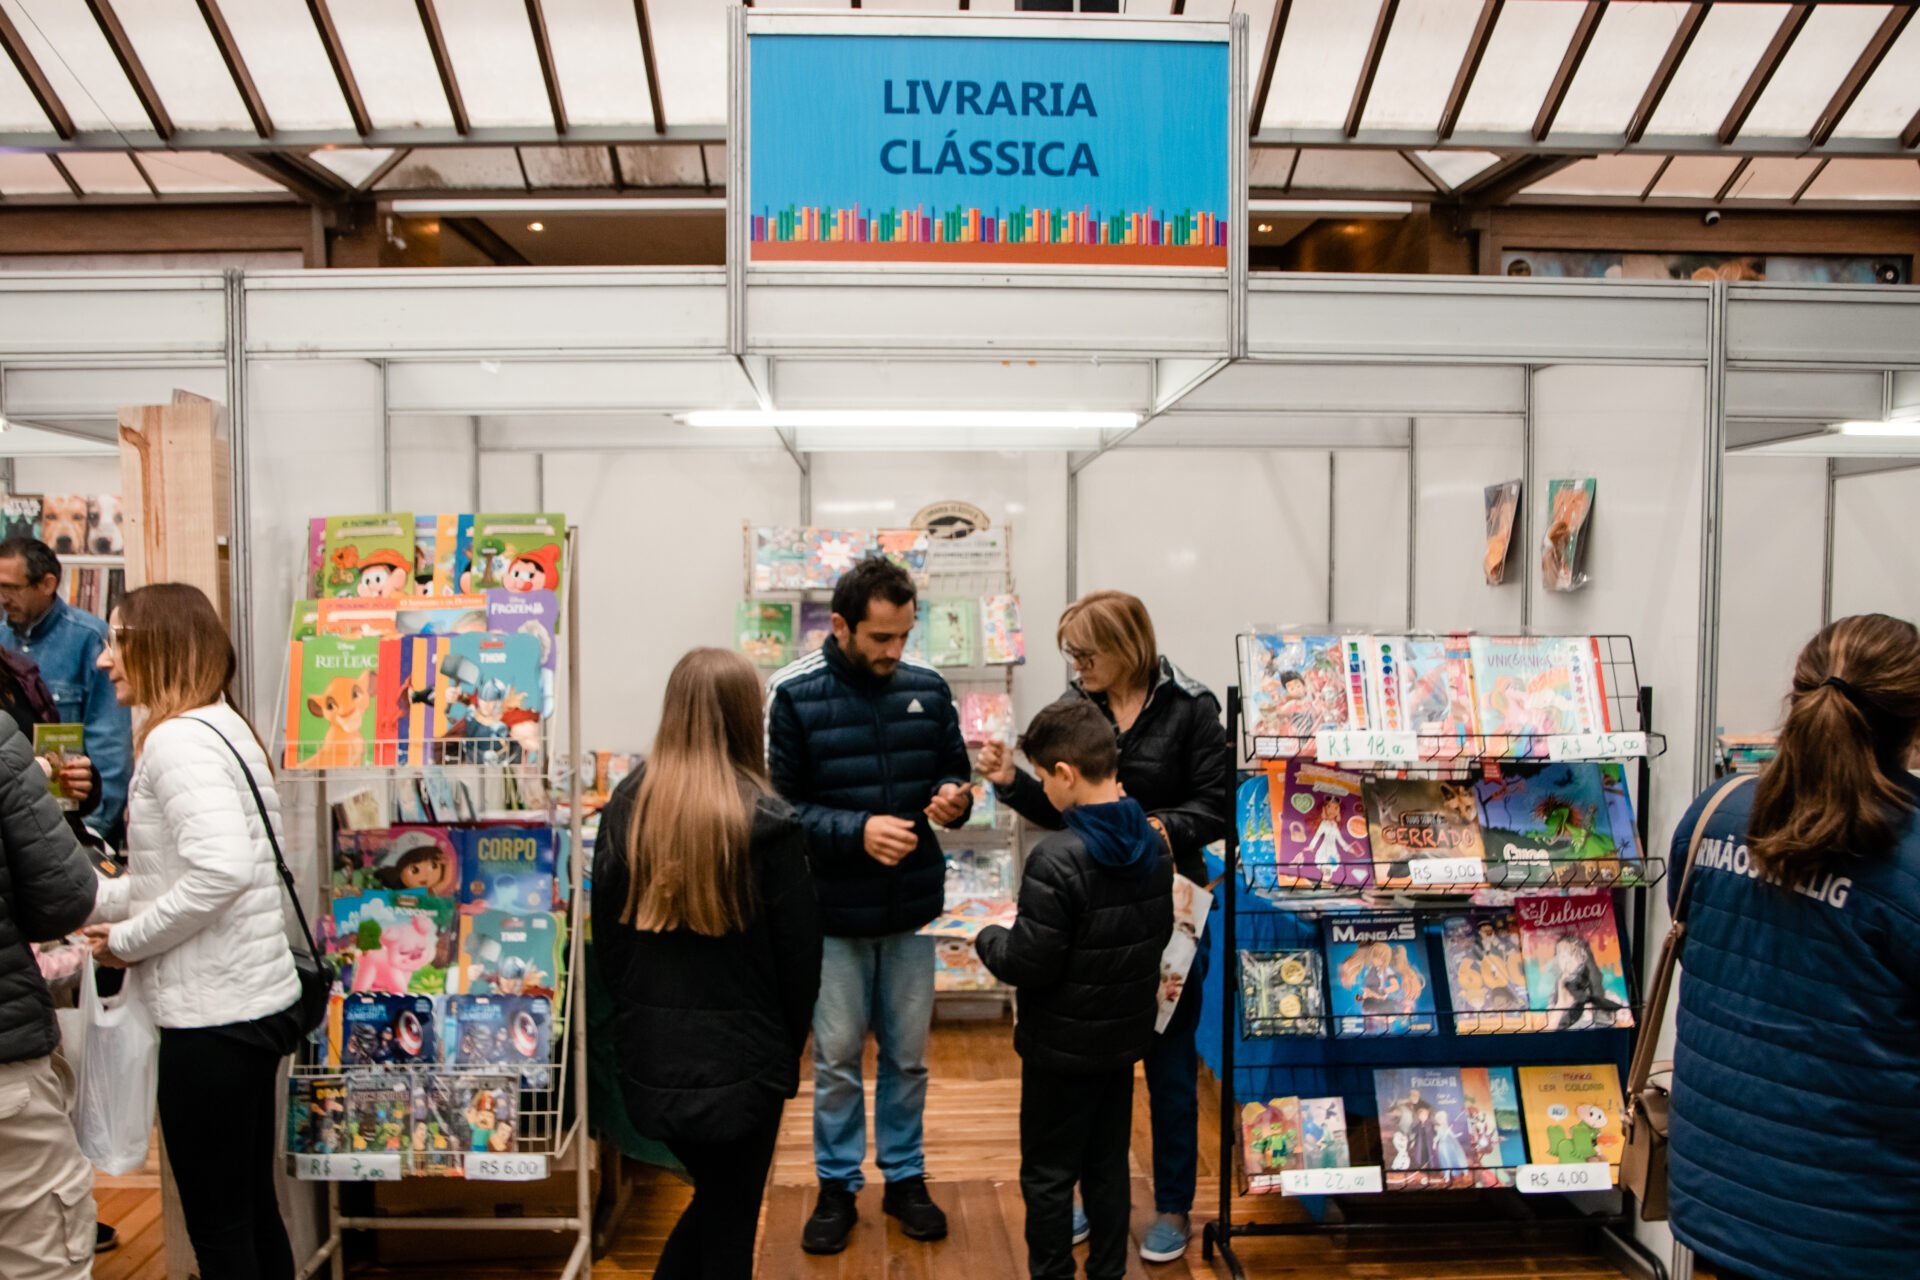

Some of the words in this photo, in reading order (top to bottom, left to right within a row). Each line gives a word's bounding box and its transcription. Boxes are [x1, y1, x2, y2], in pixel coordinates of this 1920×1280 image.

[883, 80, 1098, 118] LIVRARIA
[879, 129, 1100, 178] CLÁSSICA
[1382, 826, 1475, 848] CERRADO
[478, 837, 538, 860] CORPO
[1413, 866, 1432, 881] R$
[1444, 864, 1475, 880] 9,00
[1533, 899, 1608, 927] Luluca
[311, 1158, 332, 1176] R$
[480, 1159, 499, 1175] R$
[1531, 1172, 1549, 1187] R$
[1557, 1171, 1589, 1186] 4,00
